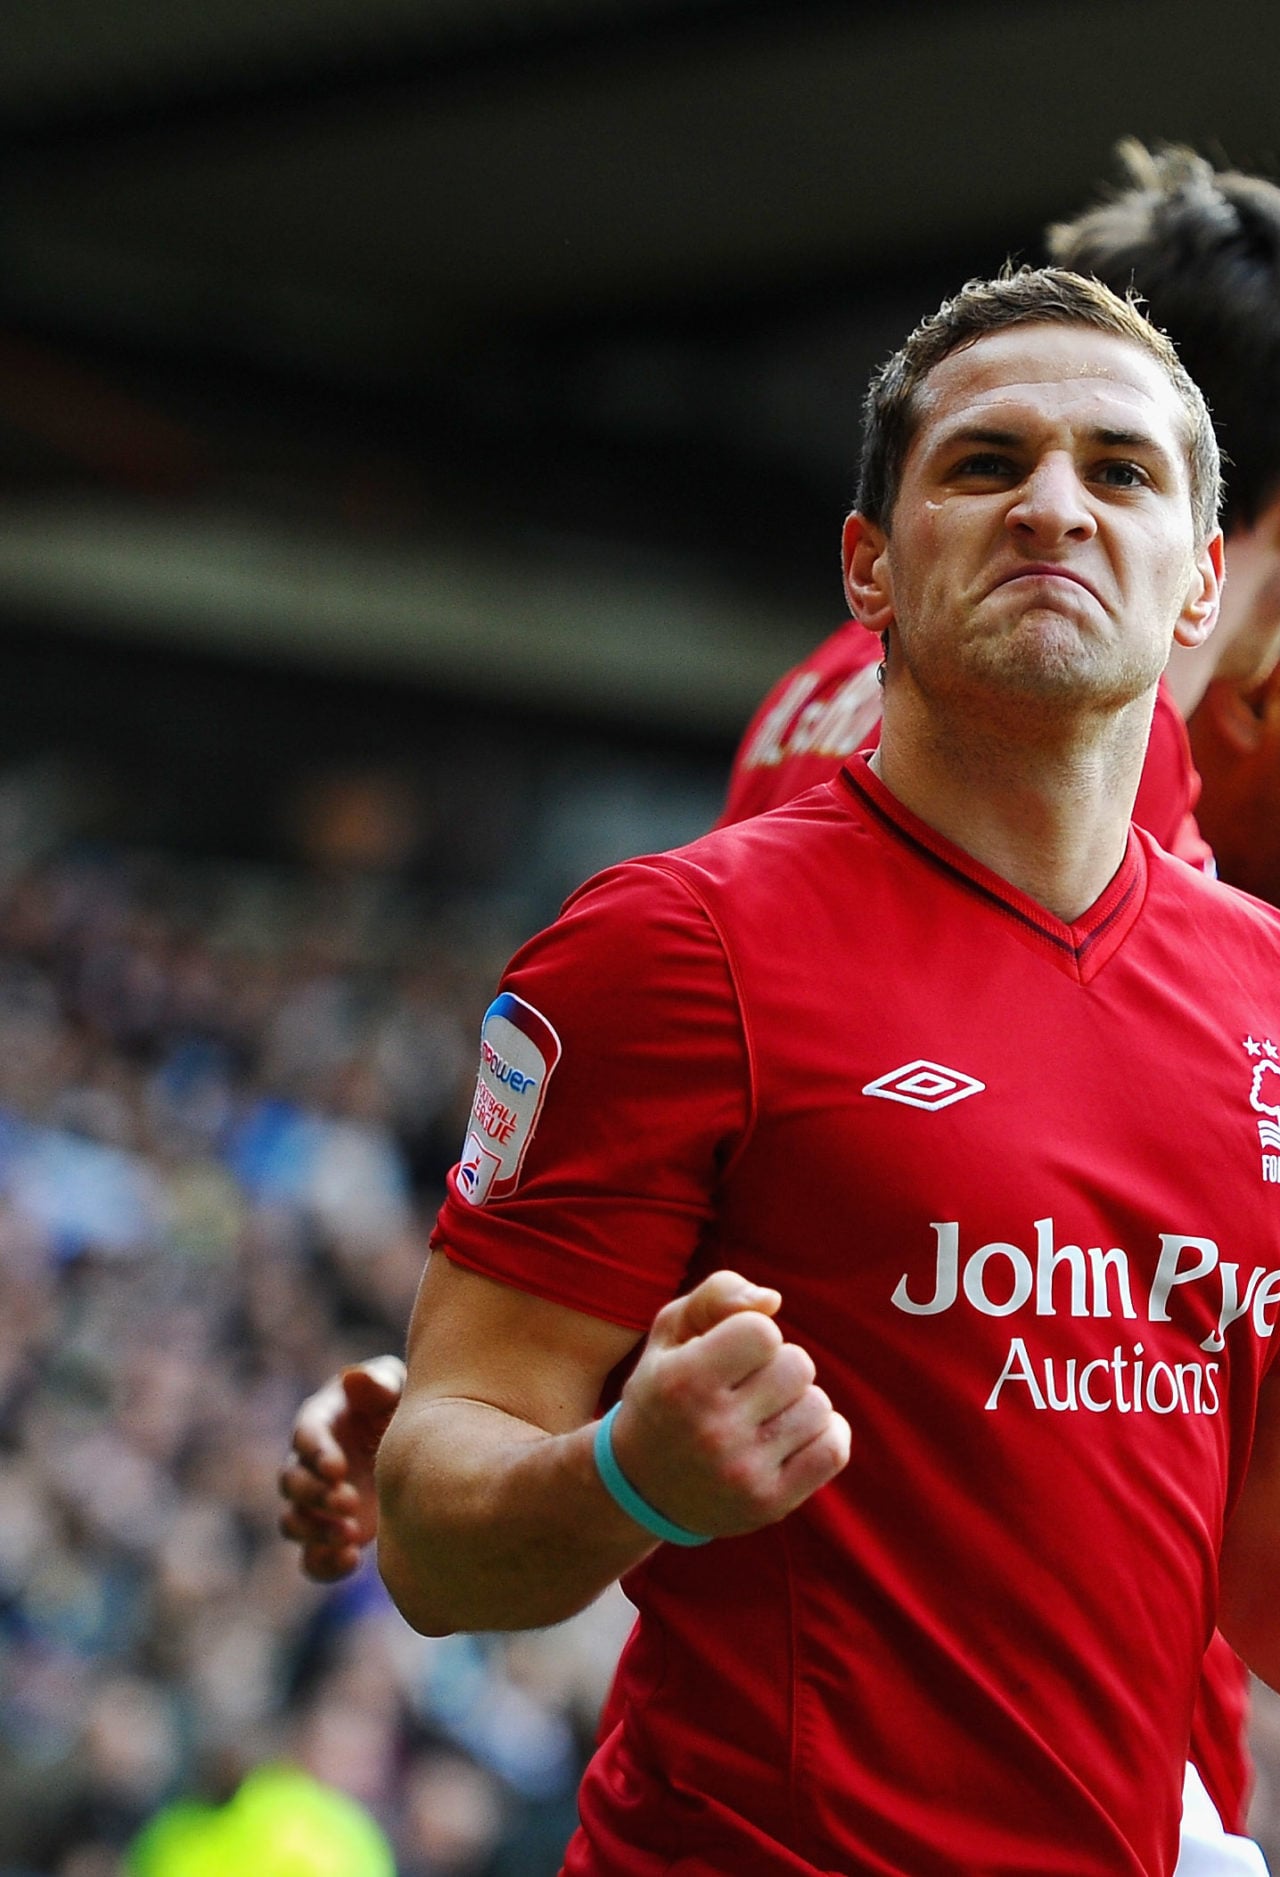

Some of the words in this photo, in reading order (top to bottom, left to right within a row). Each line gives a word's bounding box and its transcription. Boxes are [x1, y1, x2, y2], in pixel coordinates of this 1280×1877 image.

[473, 1096, 517, 1147] LEAGUE
[890, 1217, 1138, 1318] John
[984, 1337, 1220, 1415] Auctions
